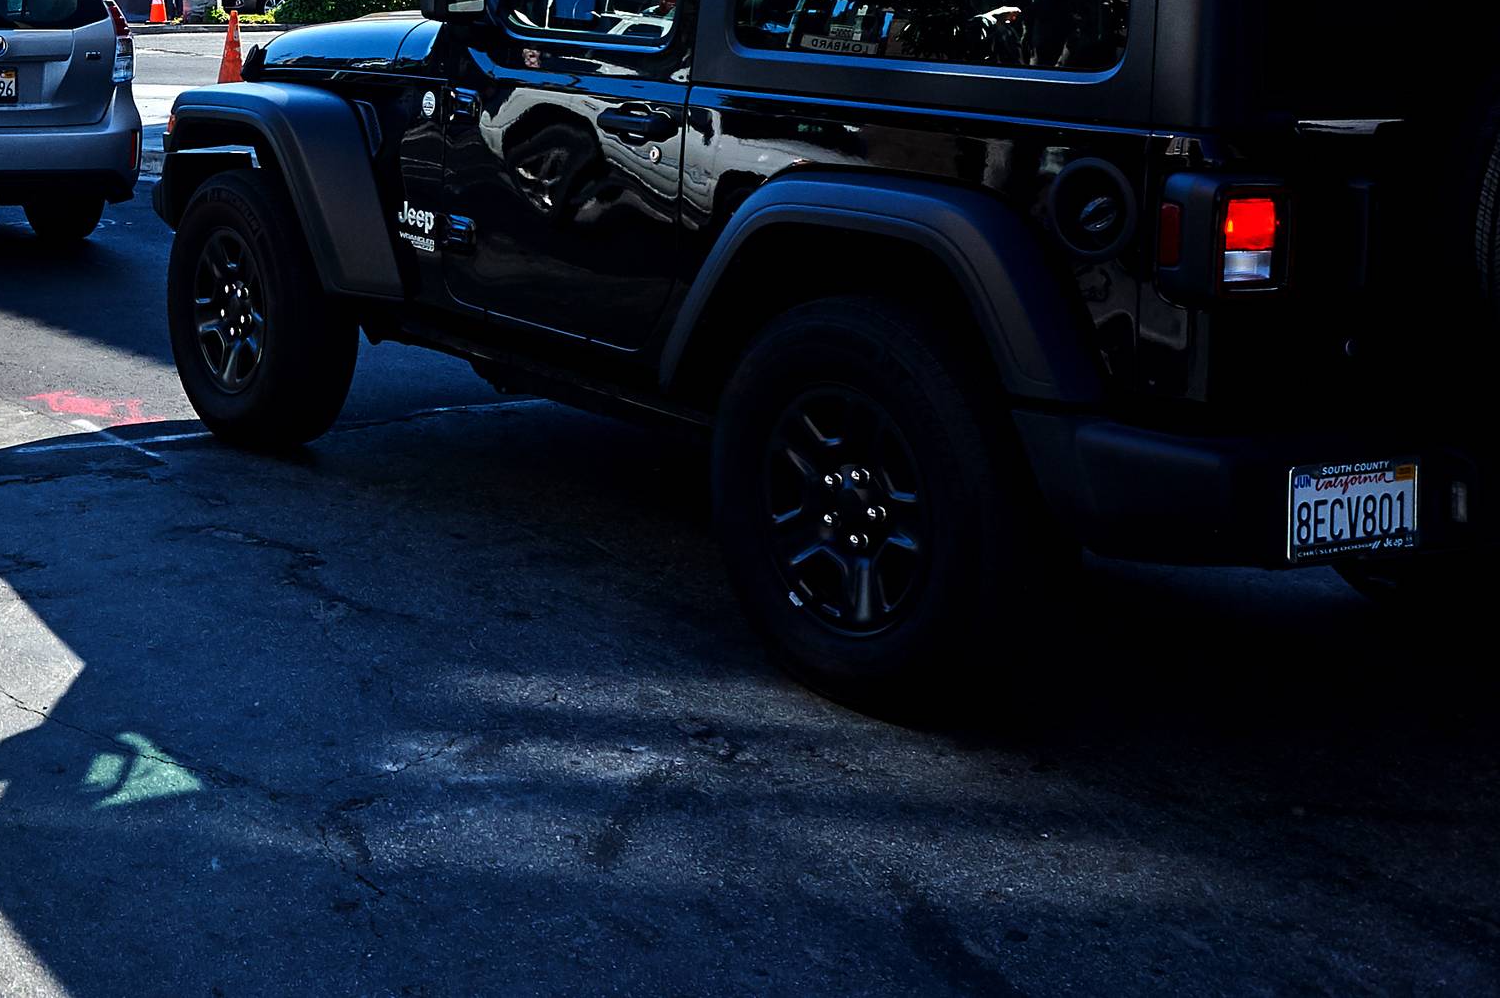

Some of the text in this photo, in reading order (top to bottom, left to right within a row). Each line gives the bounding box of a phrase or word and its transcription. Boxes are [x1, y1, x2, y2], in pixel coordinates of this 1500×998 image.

[398, 201, 435, 234] Jeep
[1322, 460, 1390, 476] SOUTH COUNTY
[1294, 475, 1312, 489] JUN
[1315, 471, 1394, 495] California
[1296, 491, 1409, 544] 8ECV801
